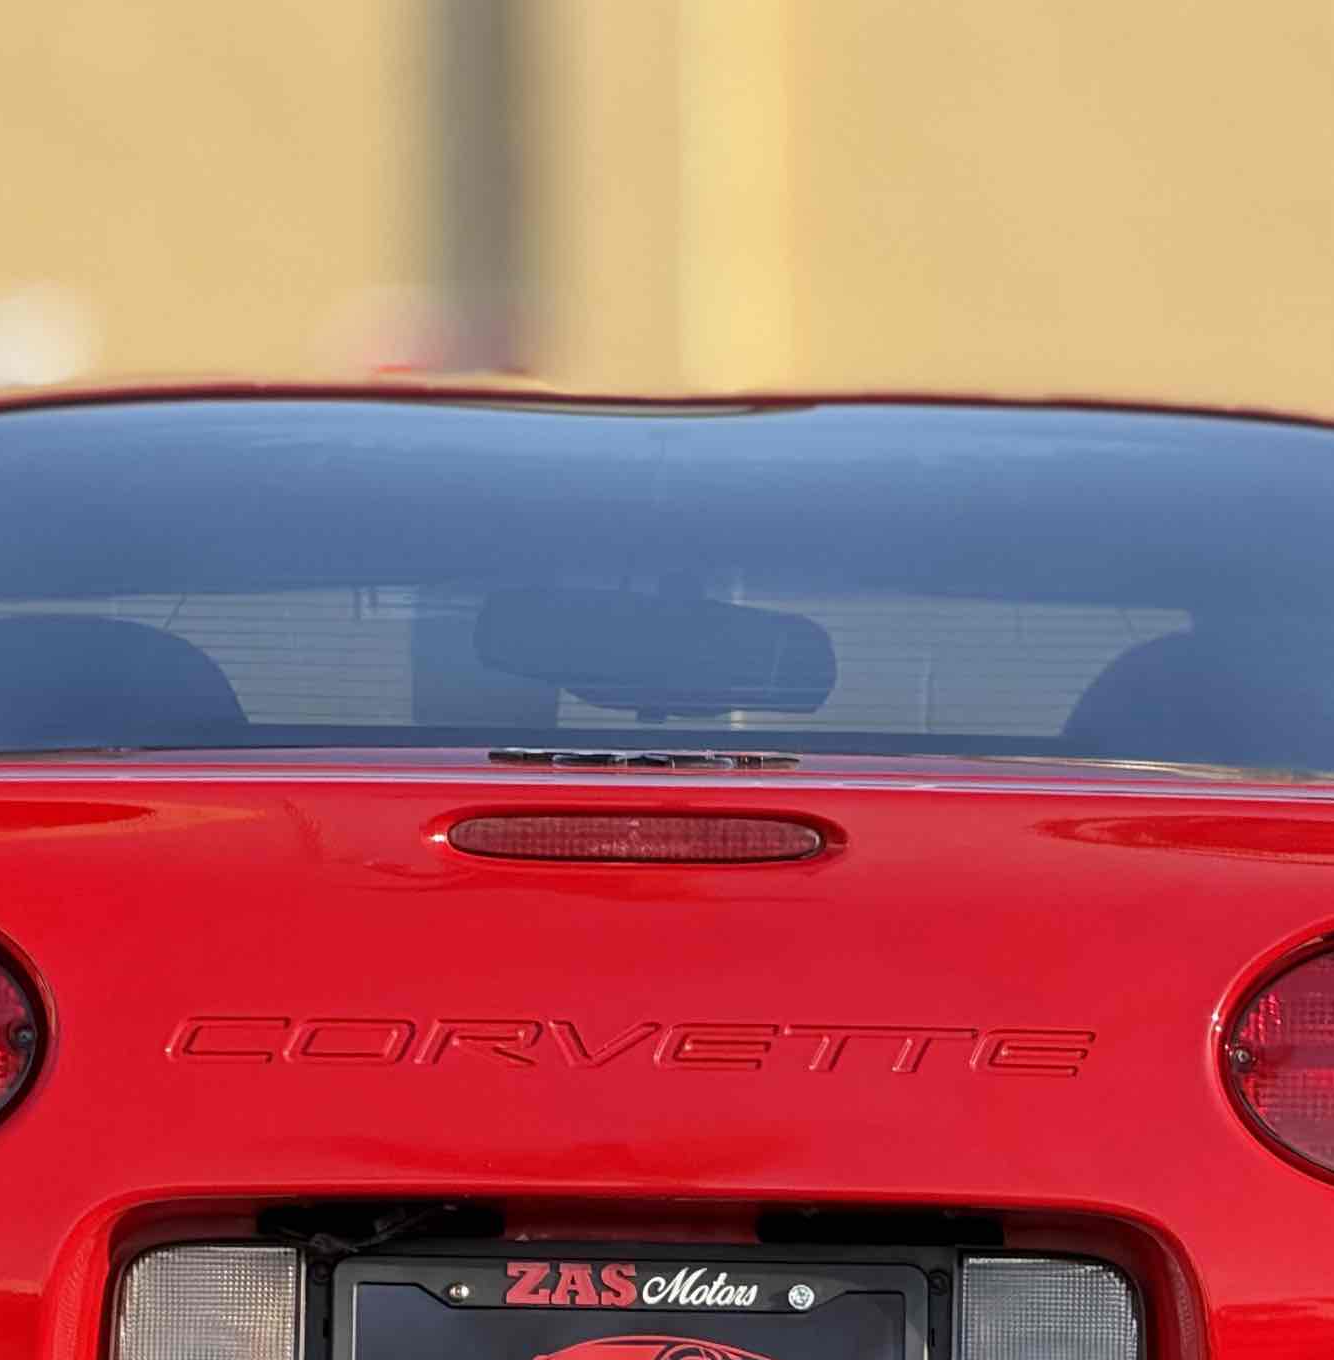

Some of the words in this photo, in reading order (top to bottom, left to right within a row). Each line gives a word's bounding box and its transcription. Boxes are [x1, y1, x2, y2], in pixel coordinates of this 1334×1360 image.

[165, 1014, 1096, 1078] CORVETTE
[505, 1262, 637, 1307] ZAS
[642, 1267, 759, 1307] Motors
